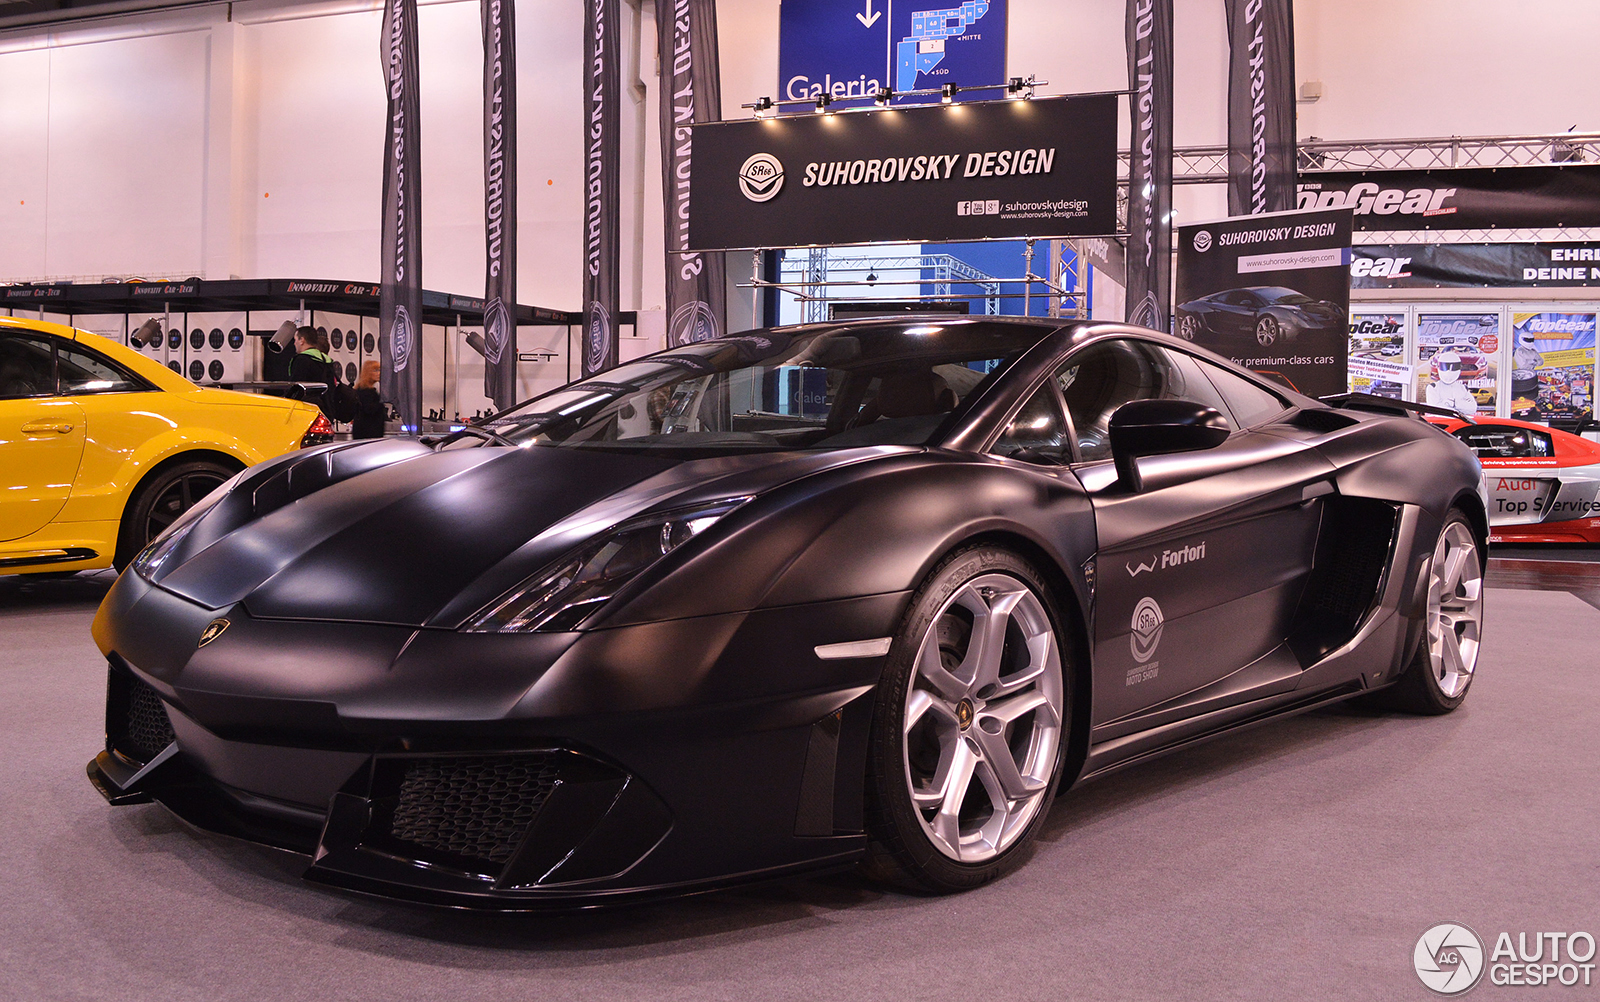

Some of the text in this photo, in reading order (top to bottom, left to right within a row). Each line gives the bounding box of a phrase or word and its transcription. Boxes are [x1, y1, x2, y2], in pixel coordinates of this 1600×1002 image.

[936, 68, 950, 76] SÜD
[786, 74, 880, 101] Galeria
[751, 165, 772, 175] SR66
[803, 148, 1055, 188] SUHOROVSKY DESIGN
[1005, 199, 1088, 213] suhorovskydesign
[1297, 182, 1457, 216] opGear
[1001, 210, 1088, 219] www.suhorovsky-design.com
[1423, 208, 1457, 216] DEUTSCHLAND
[1219, 223, 1336, 246] SUHOROVSKY DESIGN
[1246, 254, 1335, 267] www.suhorovsky-design.com
[1523, 268, 1586, 280] DEINE
[286, 282, 339, 292] INNOVATIV
[1420, 320, 1498, 338] TopGear
[1529, 319, 1595, 334] TopGear
[1231, 355, 1335, 367] for premium-class cars
[1496, 478, 1537, 492] Audi
[1496, 498, 1600, 515] Top Service
[1161, 541, 1206, 570] Fortori
